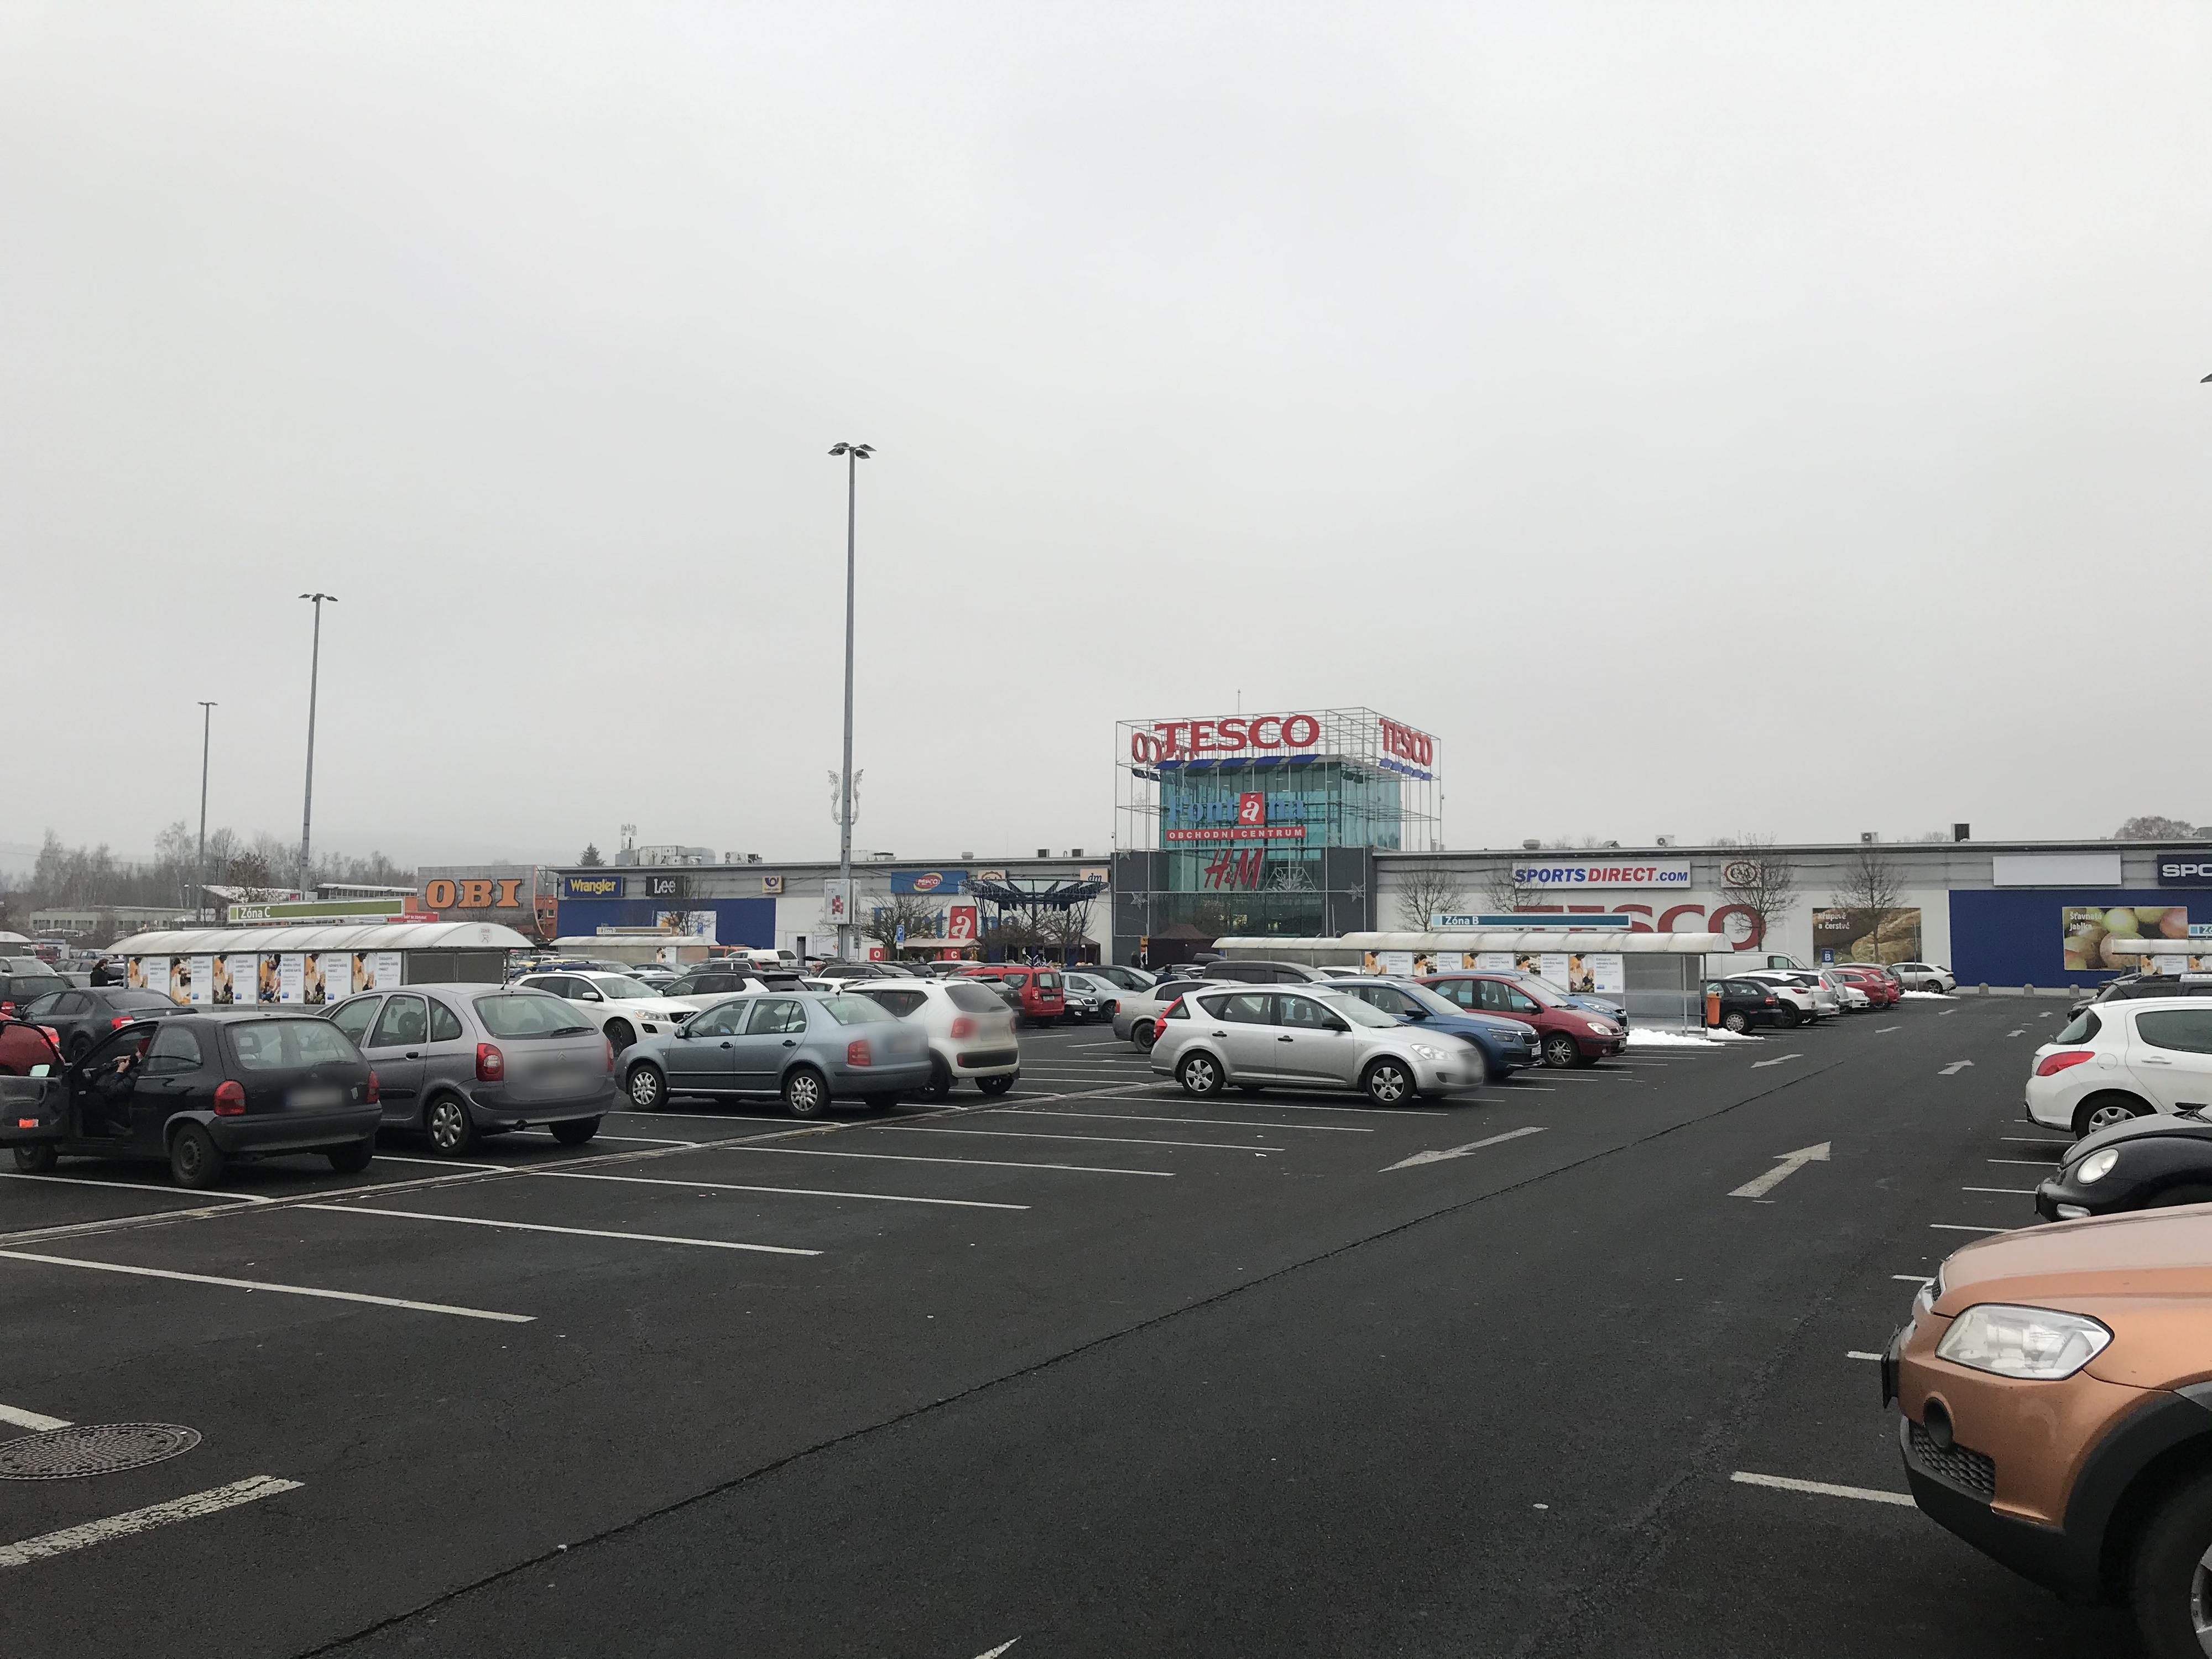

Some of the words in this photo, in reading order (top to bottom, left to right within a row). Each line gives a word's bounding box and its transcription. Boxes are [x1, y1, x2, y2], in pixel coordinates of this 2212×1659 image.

[1155, 714, 1320, 753] TESCO
[1379, 718, 1433, 766] TESCO
[1168, 795, 1306, 823] Fontána
[1169, 830, 1234, 839] OBCHODNÍ
[1241, 829, 1302, 838] CENTRUM
[1204, 847, 1265, 890] H&M
[570, 878, 616, 894] Wrangler
[653, 878, 676, 894] Lee
[1088, 873, 1102, 883] dm
[425, 878, 523, 909] OBI
[241, 907, 263, 919] Zóna
[264, 906, 270, 918] C
[1445, 915, 1470, 925] Zóna
[1472, 916, 1479, 925] B
